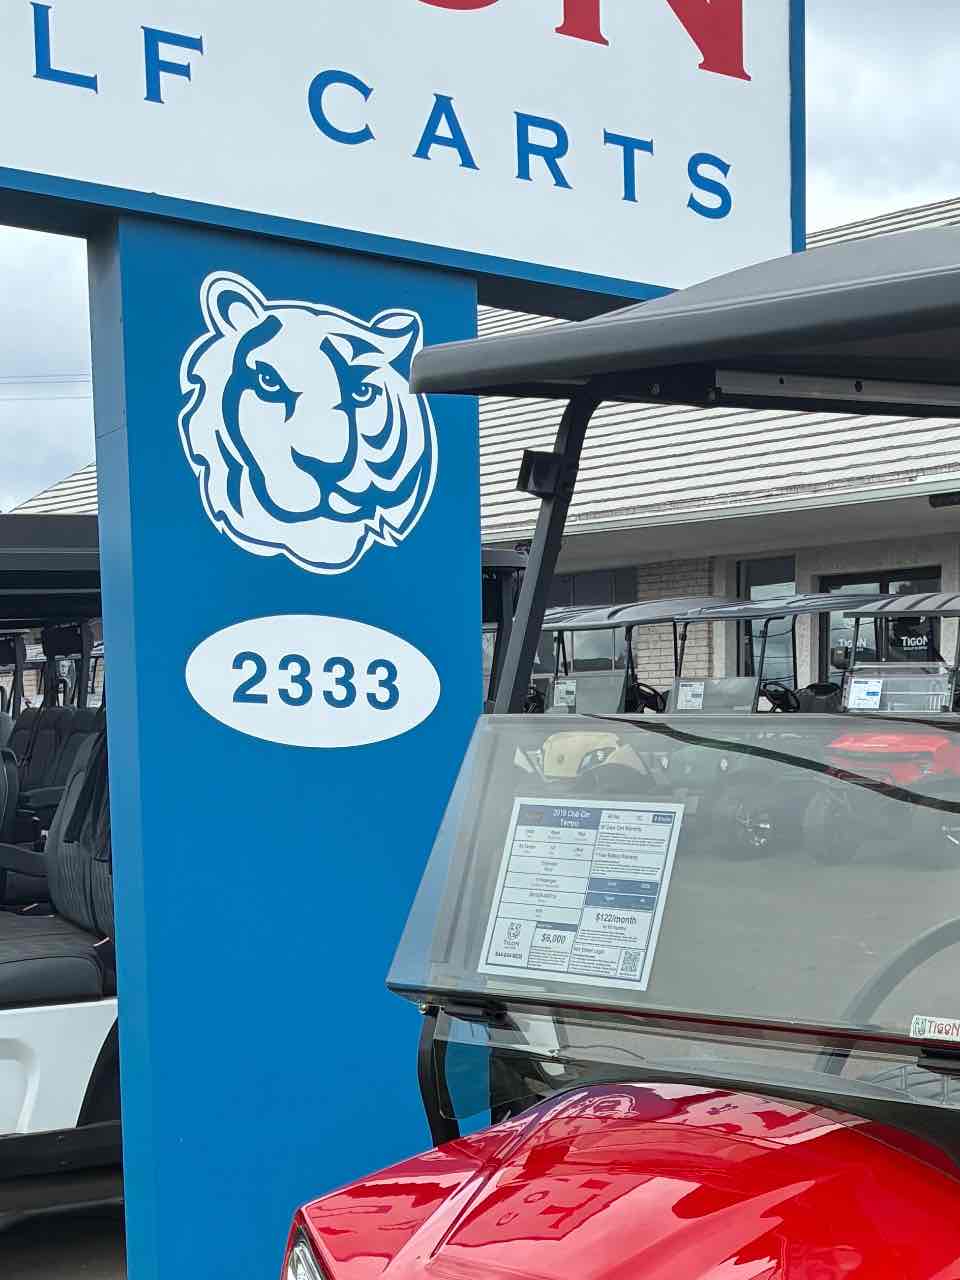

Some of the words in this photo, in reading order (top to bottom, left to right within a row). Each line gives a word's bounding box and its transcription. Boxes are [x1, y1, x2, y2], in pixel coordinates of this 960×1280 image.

[307, 69, 733, 219] CARTS
[838, 638, 867, 648] TIGN
[231, 650, 400, 711] 2333
[927, 1019, 960, 1037] TIGON
